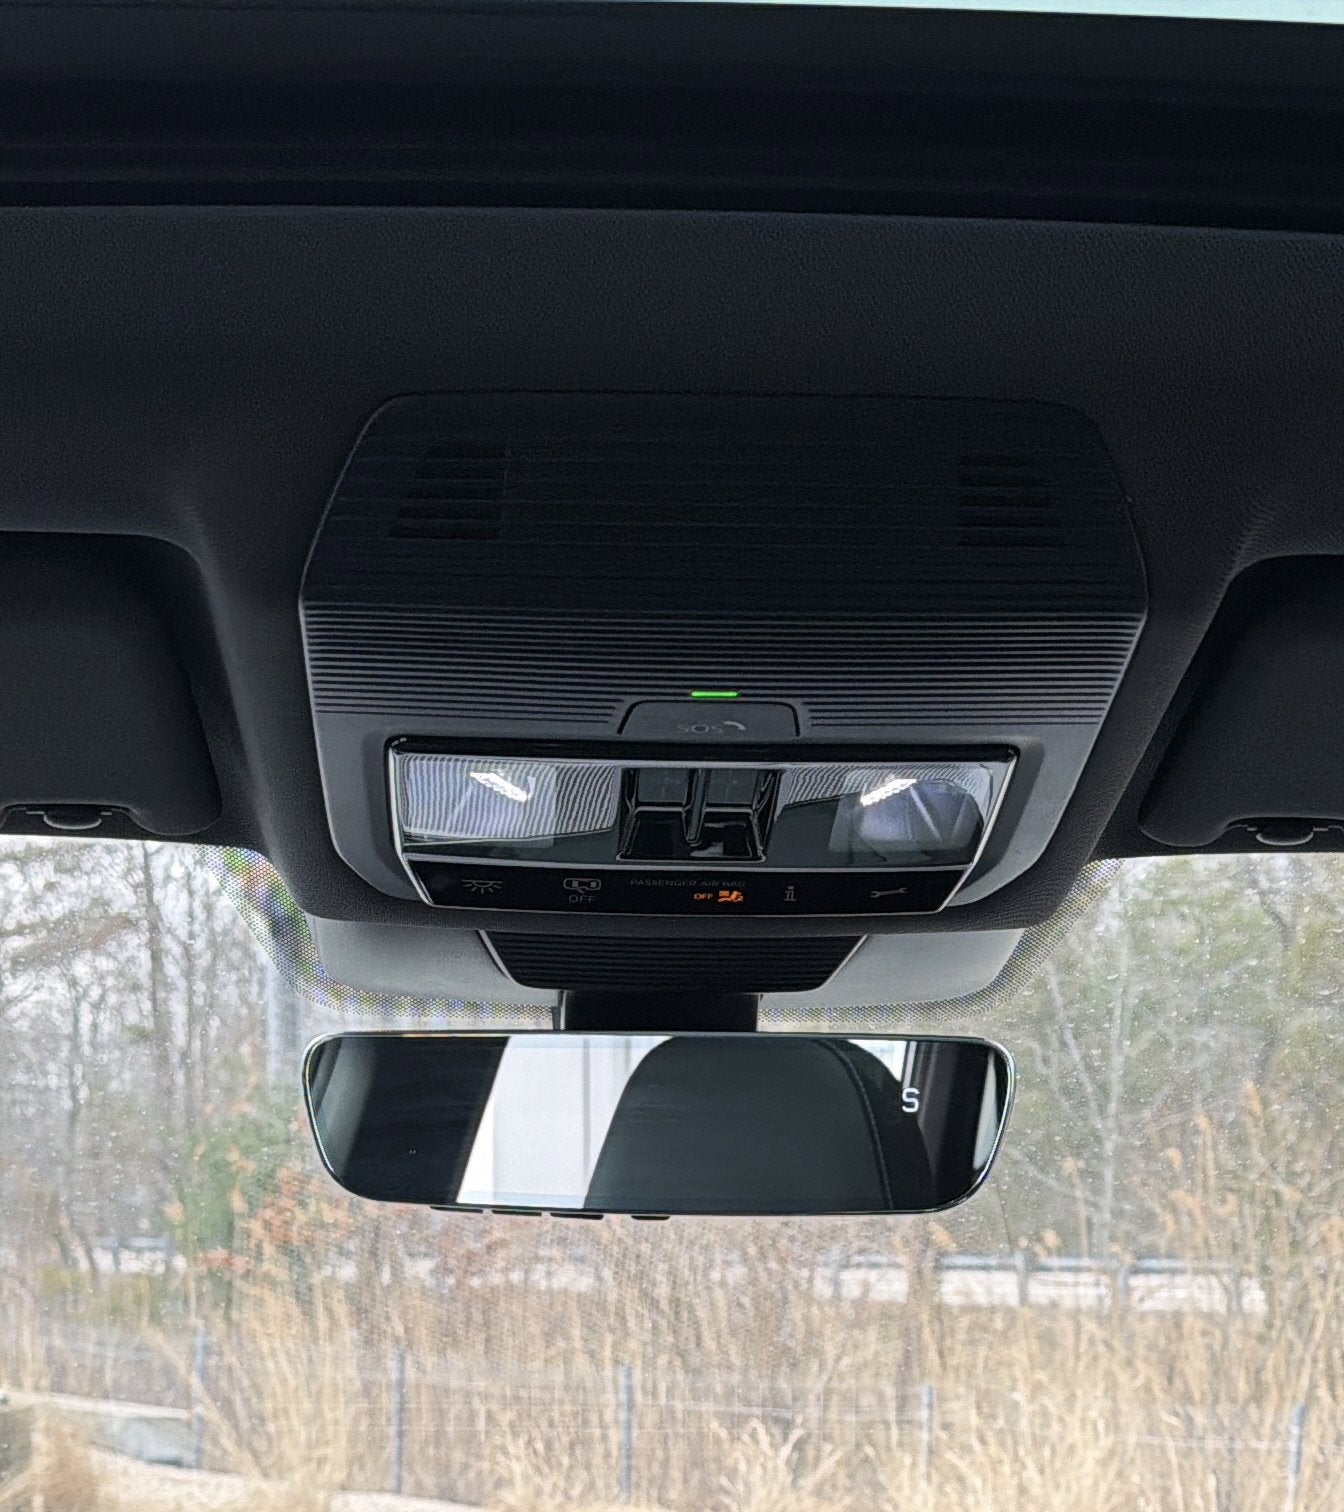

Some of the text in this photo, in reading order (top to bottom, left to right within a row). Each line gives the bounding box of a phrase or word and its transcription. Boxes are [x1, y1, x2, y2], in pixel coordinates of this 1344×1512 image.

[630, 879, 697, 888] PASSENGER
[568, 894, 597, 903] OFF
[693, 893, 714, 901] OFF
[901, 1087, 920, 1112] S
